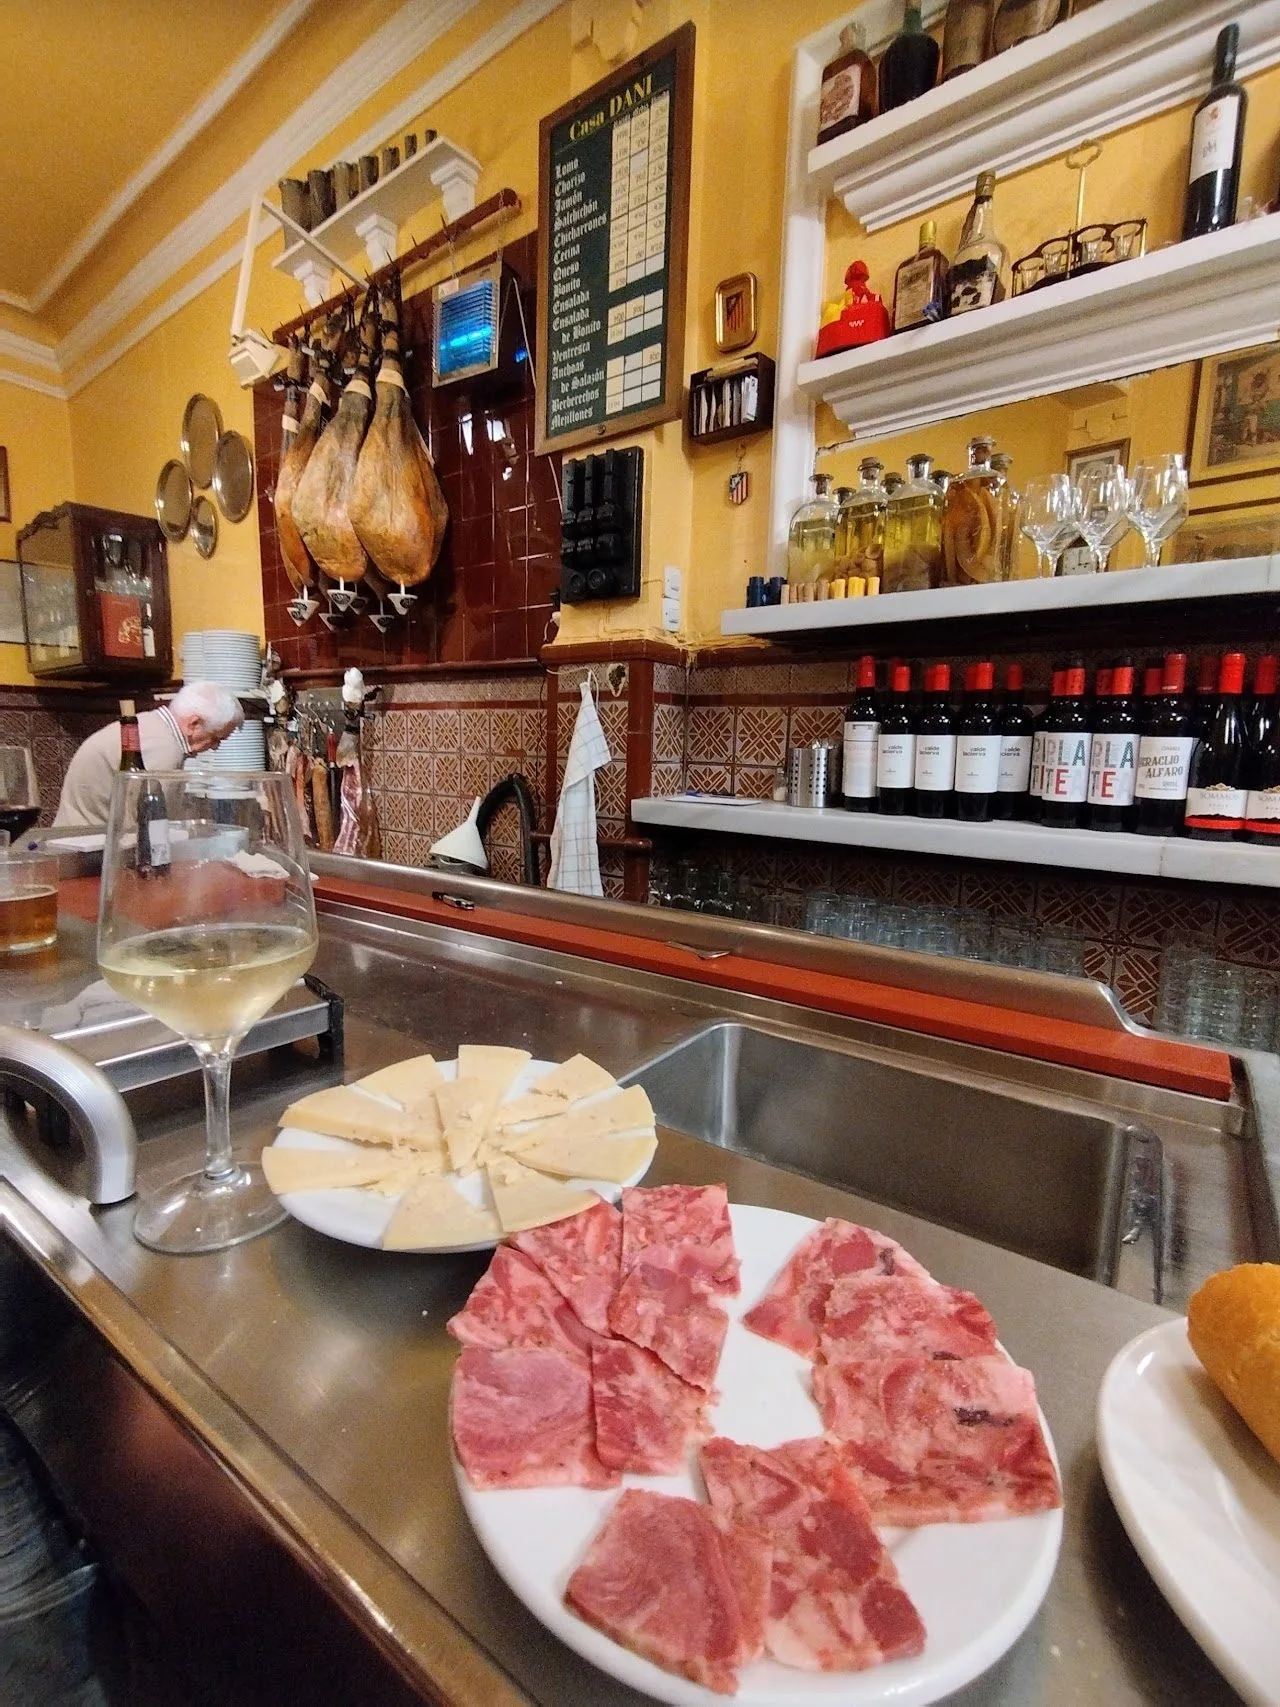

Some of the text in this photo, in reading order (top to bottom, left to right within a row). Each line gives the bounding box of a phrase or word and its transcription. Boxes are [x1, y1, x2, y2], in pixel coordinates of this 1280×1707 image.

[569, 72, 653, 142] Casa DANI
[555, 158, 579, 179] Lomo
[554, 172, 586, 197] Chorizo
[554, 189, 583, 217] Jamón
[554, 199, 598, 232] Salchichón
[553, 212, 607, 248] Chicharrones
[553, 243, 580, 265] Cecina
[553, 261, 580, 281] Queso
[553, 278, 581, 300] Bonito
[552, 290, 590, 315] Ensalada
[552, 308, 590, 331] Ensalada
[561, 320, 601, 344] de Bonito
[552, 342, 591, 364] Ventresca
[551, 360, 585, 380] Anchoas
[560, 368, 605, 393] de Salazón
[551, 388, 600, 413] Berberechos
[551, 406, 594, 430] Mejillones
[1145, 765, 1184, 780] ALFARO
